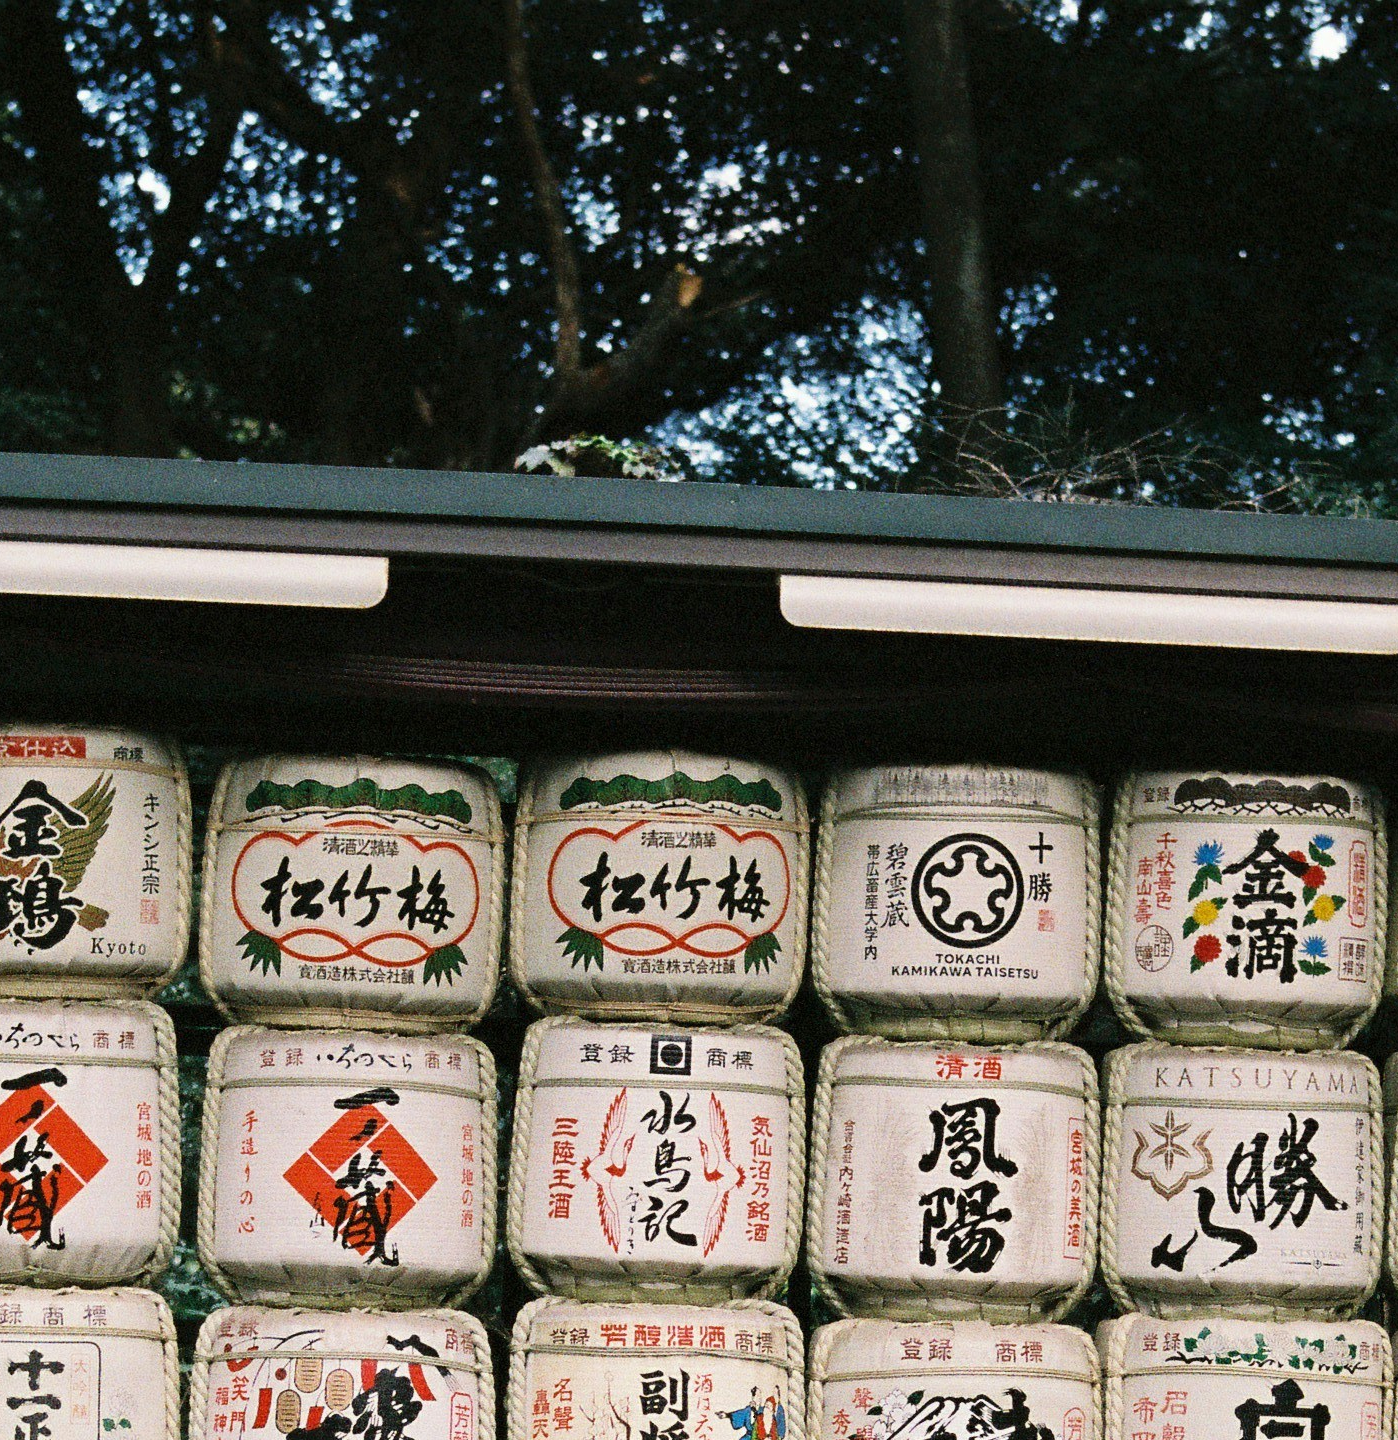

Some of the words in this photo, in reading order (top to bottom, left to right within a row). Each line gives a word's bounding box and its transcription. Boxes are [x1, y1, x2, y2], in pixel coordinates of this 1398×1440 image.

[142, 793, 161, 894] キンシ正宗
[1028, 832, 1053, 902] 十勝
[1155, 832, 1177, 910] 千秋喜色
[261, 858, 455, 933] 松竹梅
[580, 853, 769, 921] 松竹梅
[865, 844, 879, 961] 帯広畜産大学内
[881, 843, 910, 929] 碧雲蔵
[1223, 829, 1311, 984] 金滴
[91, 938, 147, 957] Kyoto
[891, 966, 971, 977] KAMIKAWA
[976, 968, 1038, 979] TAISETSU
[935, 955, 1000, 964] TOKACHI
[580, 1042, 633, 1064] 登録
[706, 1049, 754, 1072] 商標
[936, 1054, 1003, 1081] 清酒
[1155, 1066, 1358, 1095] KATSUYAMA
[239, 1110, 259, 1234] 手造りの心
[549, 1117, 579, 1219] 三陸王酒
[639, 1092, 697, 1247] 水鳥記
[746, 1116, 774, 1242] 気仙沼乃銘酒
[919, 1098, 1018, 1273] 鳳陽
[1151, 1112, 1348, 1272] 勝山
[901, 1339, 951, 1361] 登録
[995, 1341, 1042, 1362] 商標
